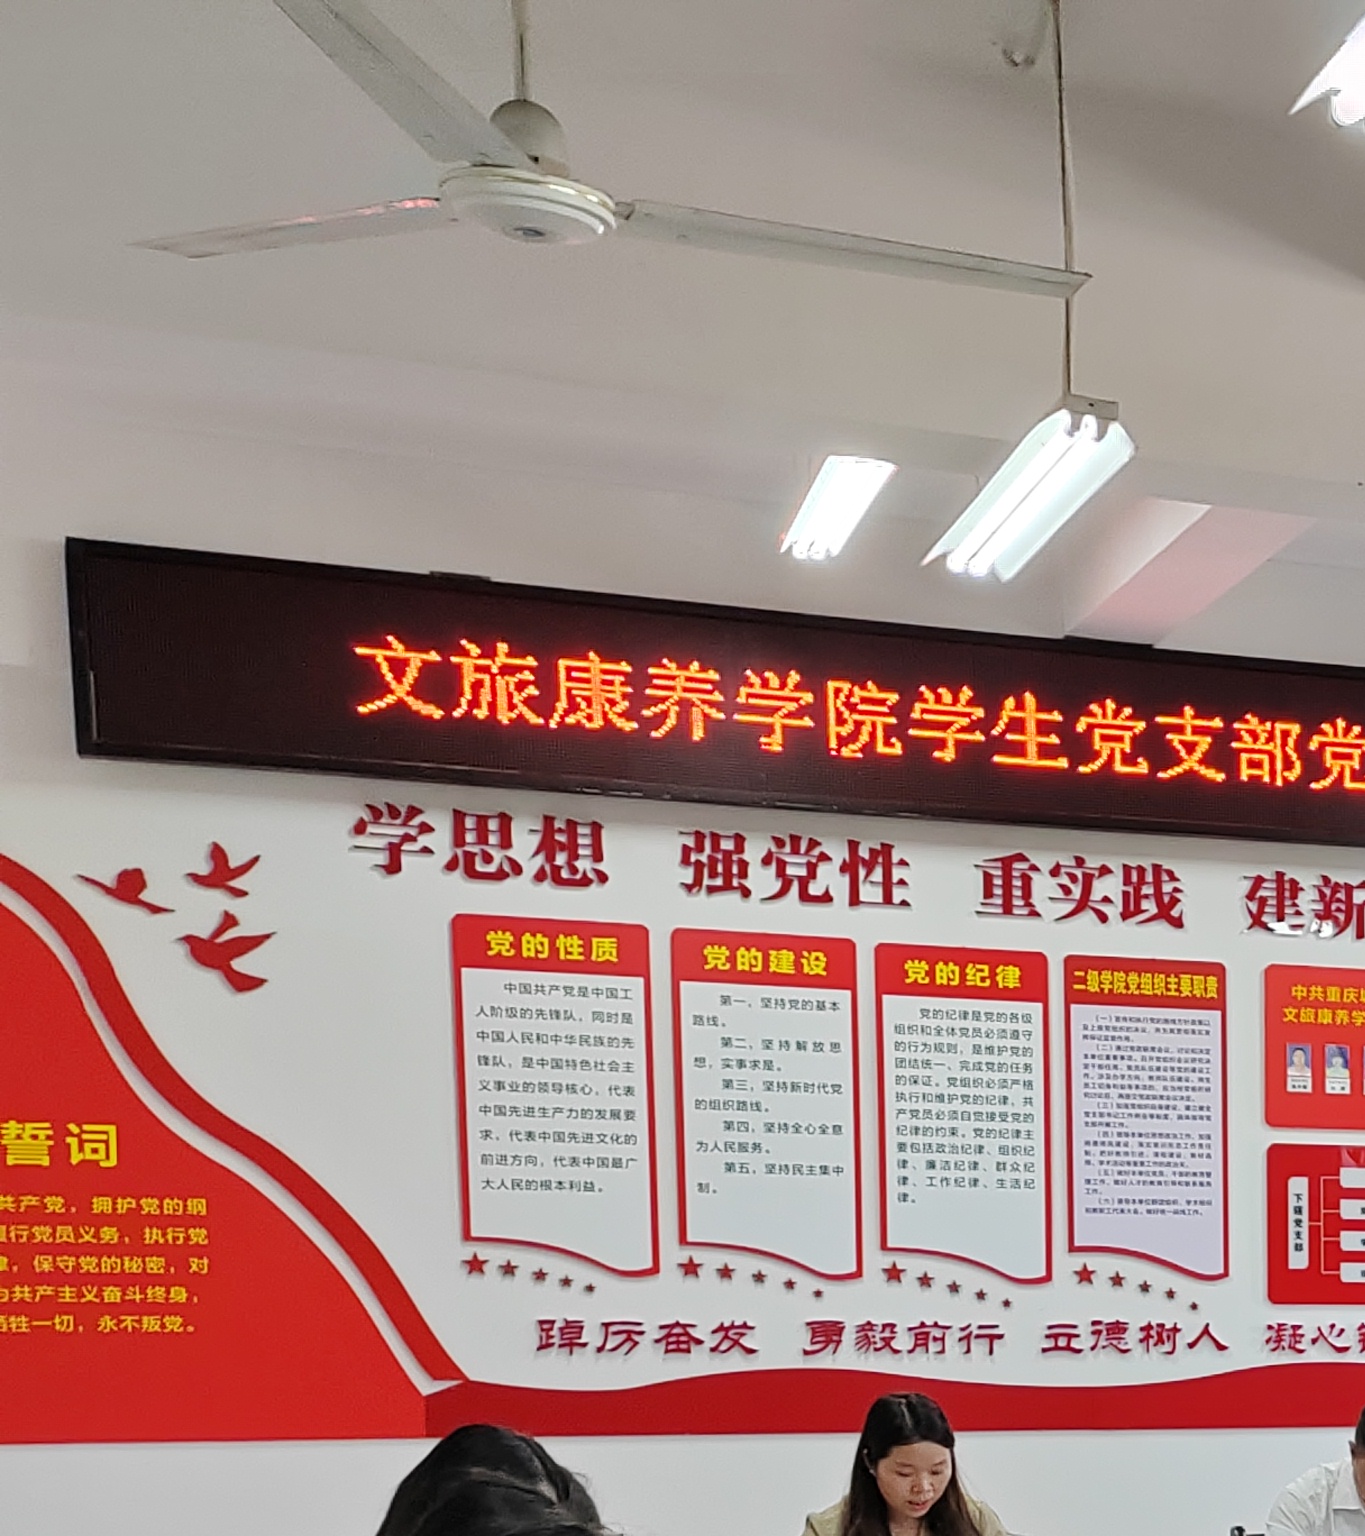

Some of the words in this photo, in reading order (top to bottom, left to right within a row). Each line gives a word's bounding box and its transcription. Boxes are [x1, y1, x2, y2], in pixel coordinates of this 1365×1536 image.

[350, 802, 609, 887] 学思想
[679, 829, 912, 910] 强党性
[974, 854, 1184, 928] 重实践
[486, 930, 620, 963] 党的性质
[703, 945, 829, 976] 党的建设
[904, 959, 1022, 989] 党的纪律
[503, 981, 634, 1000] 中国共产党是中国工
[1072, 968, 1219, 1000] 二级学院党组织主要职责
[692, 1014, 726, 1028] 路线。
[919, 1007, 1034, 1025] 党的纪律是党的各级
[476, 1030, 635, 1049] 中国人民和中华民族的先
[893, 1023, 1033, 1042] 组织和全体党员必须遵守
[477, 1054, 635, 1074] 锋队，是中国特色社会主
[693, 1056, 782, 1072] 想，实事求是。
[894, 1057, 1034, 1074] 团结统一、完成党的任务
[477, 1078, 636, 1098] 义事业的领导核心，代表
[721, 1078, 843, 1095] 第三，坚持新时代党
[478, 1103, 637, 1122] 中国先进生产力的发展要
[694, 1099, 770, 1113] 的组织路线。
[895, 1108, 1035, 1124] 产党员必须自觉接受党的
[479, 1128, 638, 1146] 求，代表中国先进文化的
[896, 1124, 1035, 1141] 纪律的约束。党的纪律主
[0, 1120, 119, 1168] 誓词
[696, 1140, 771, 1155] 为人民服务。
[480, 1153, 638, 1170] 前进方向，代表中国最广
[481, 1178, 604, 1193] 大人民的根本利益。
[897, 1175, 1036, 1190] 律、工作纪律、生活纪
[535, 1317, 759, 1356] 踔厉奋发
[802, 1319, 1005, 1357] 勇毅前行
[1041, 1319, 1229, 1356] 立德树人
